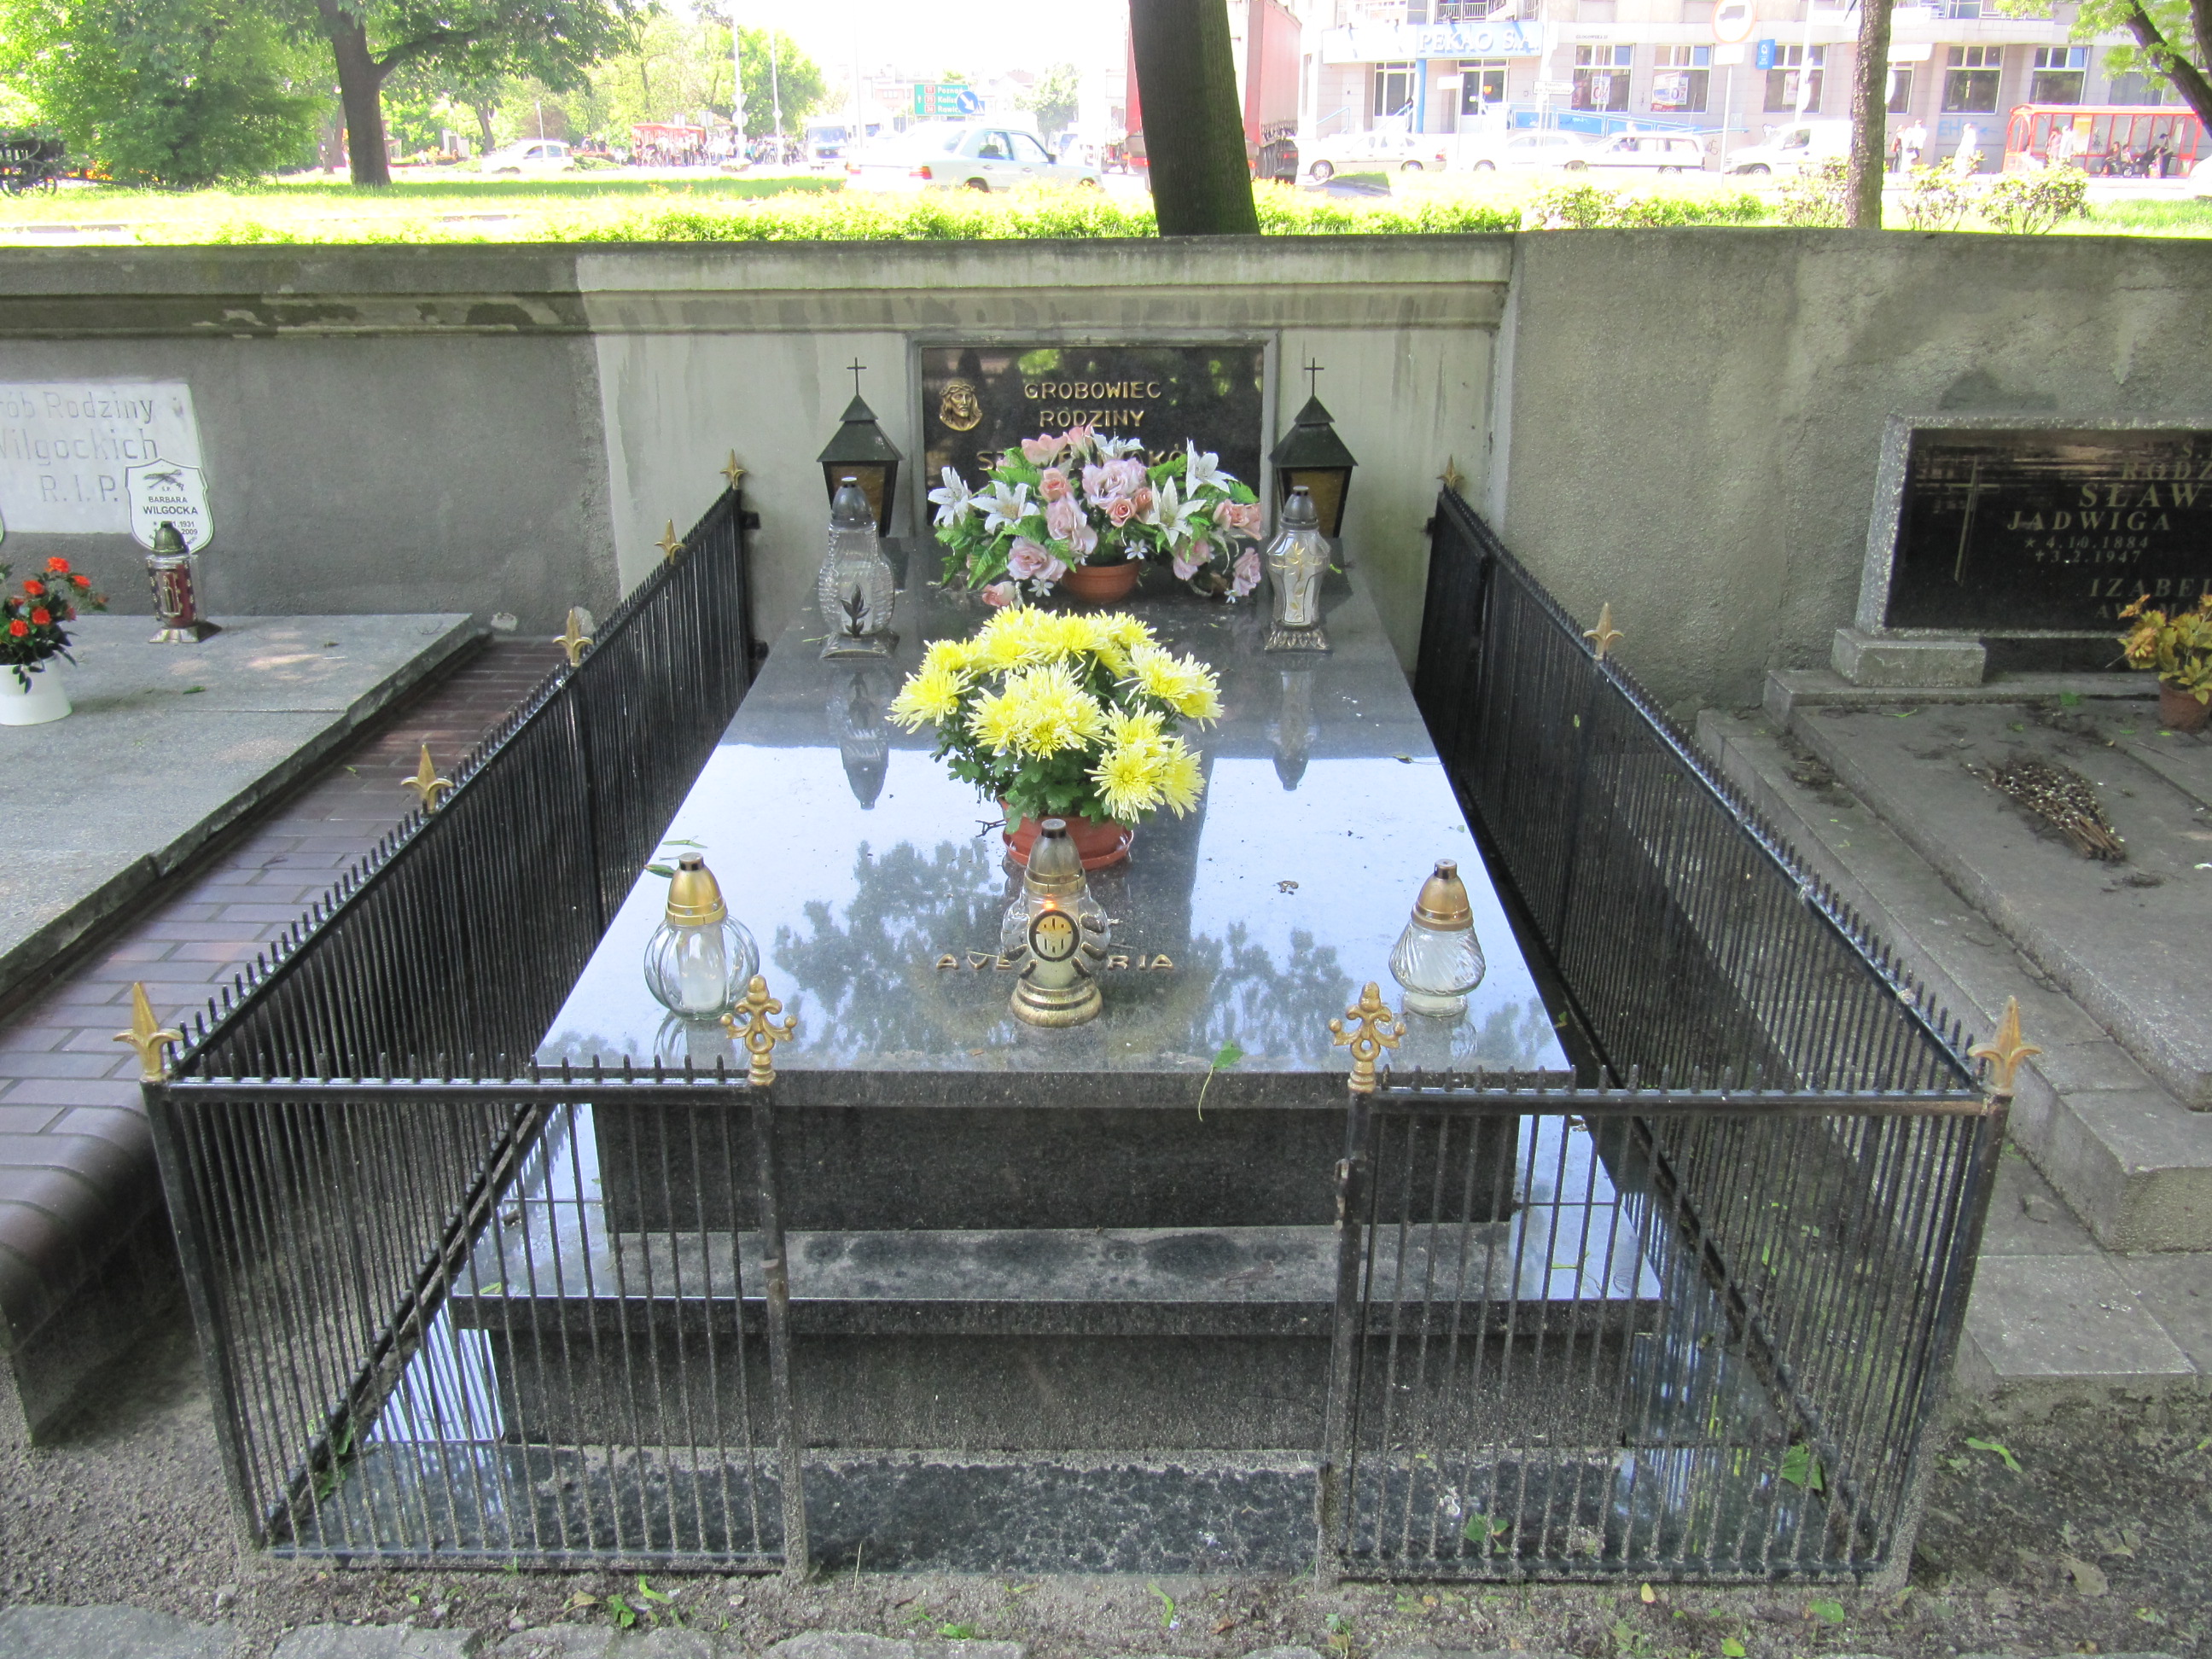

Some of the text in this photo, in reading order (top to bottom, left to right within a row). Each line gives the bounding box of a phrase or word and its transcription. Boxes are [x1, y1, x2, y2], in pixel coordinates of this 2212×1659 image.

[1419, 28, 1493, 53] PEKAO
[1024, 381, 1162, 399] GROBOWIEC
[0, 390, 153, 424] ób Rodziny
[1039, 410, 1145, 428] RODZINY
[2078, 481, 2212, 509] SŁAW
[143, 506, 199, 515] WILGOCKA
[2006, 510, 2171, 531] JADWIGA
[1106, 953, 1175, 971] RIA
